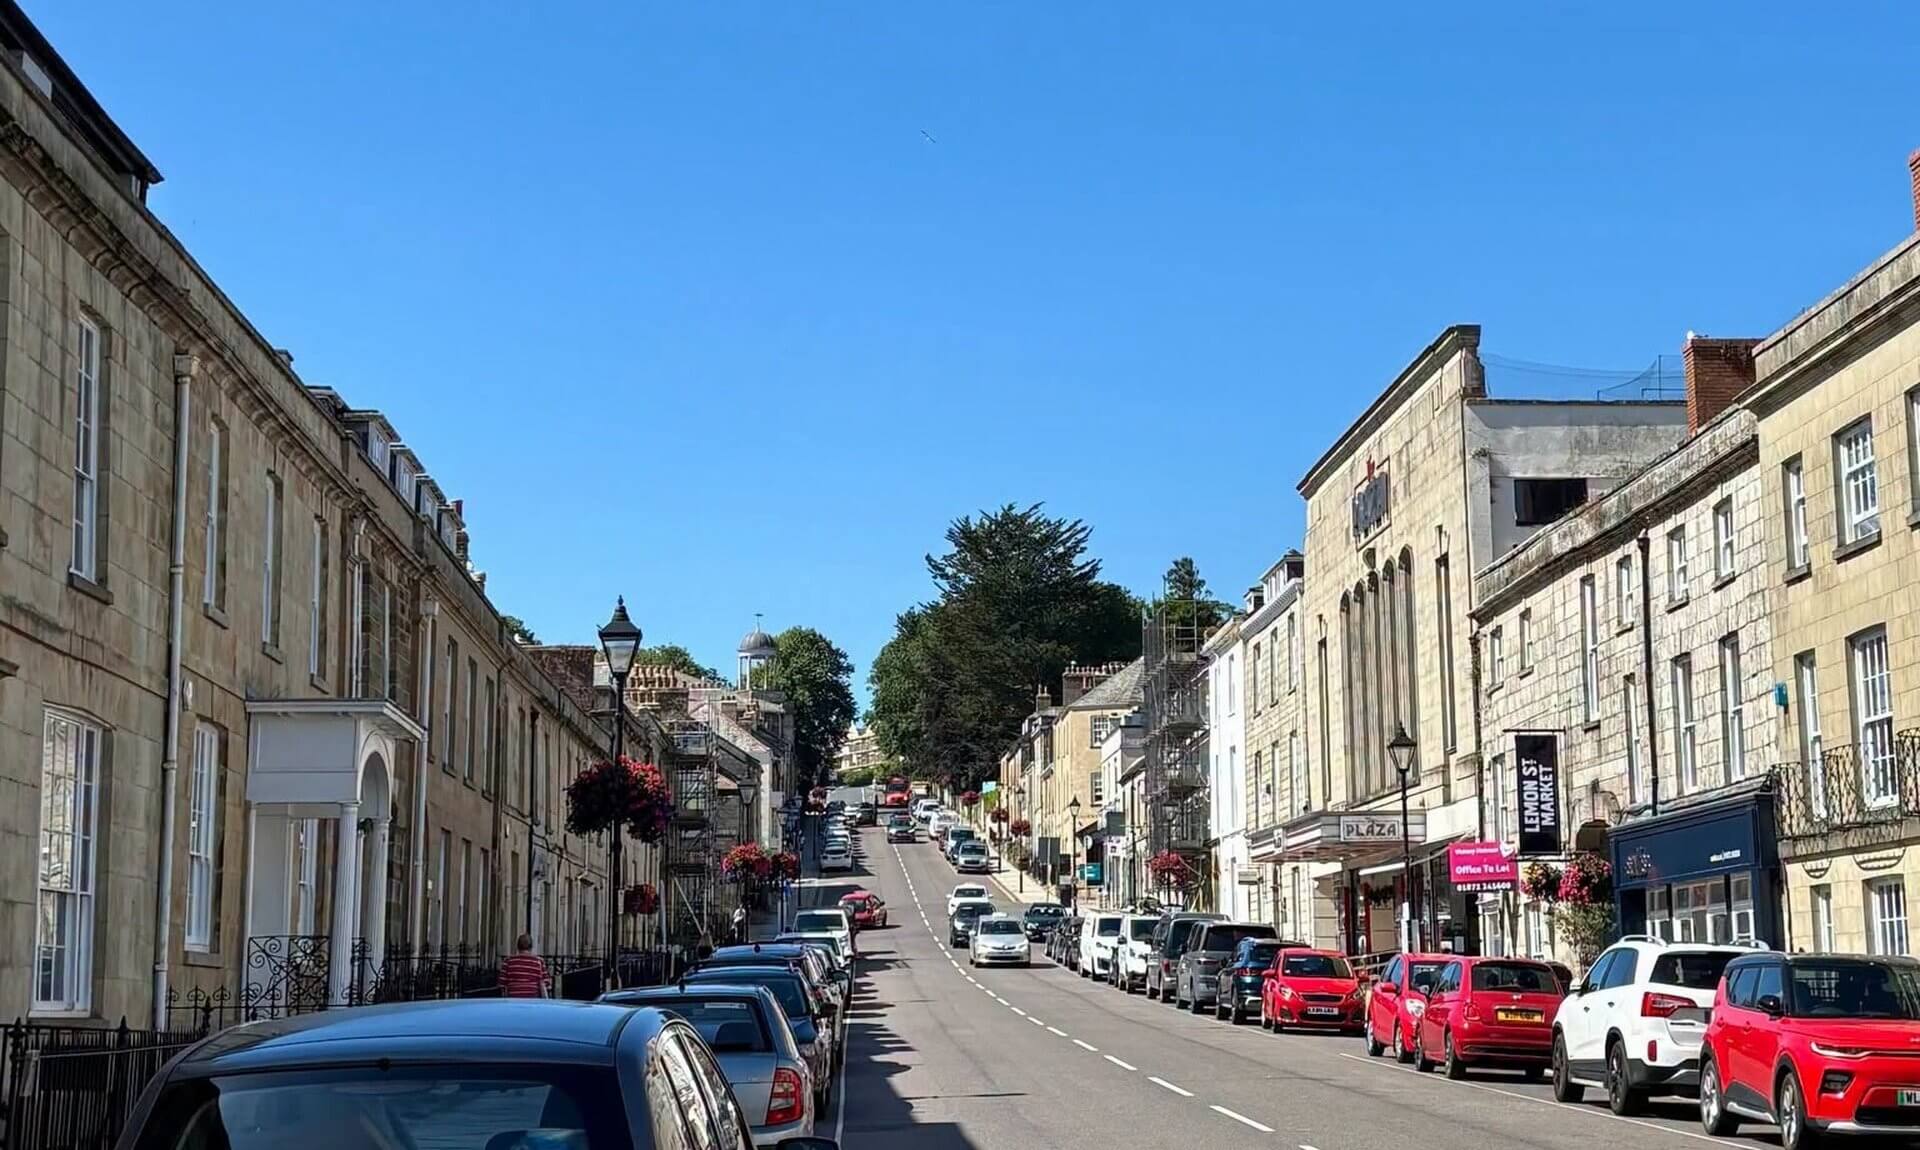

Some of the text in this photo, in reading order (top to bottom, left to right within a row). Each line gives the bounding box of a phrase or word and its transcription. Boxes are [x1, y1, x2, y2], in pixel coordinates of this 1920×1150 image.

[1523, 780, 1540, 833] LEMON
[1539, 764, 1555, 826] MARKET
[1346, 823, 1396, 836] PLAZA
[1455, 864, 1481, 875] Office
[1495, 863, 1510, 873] Let
